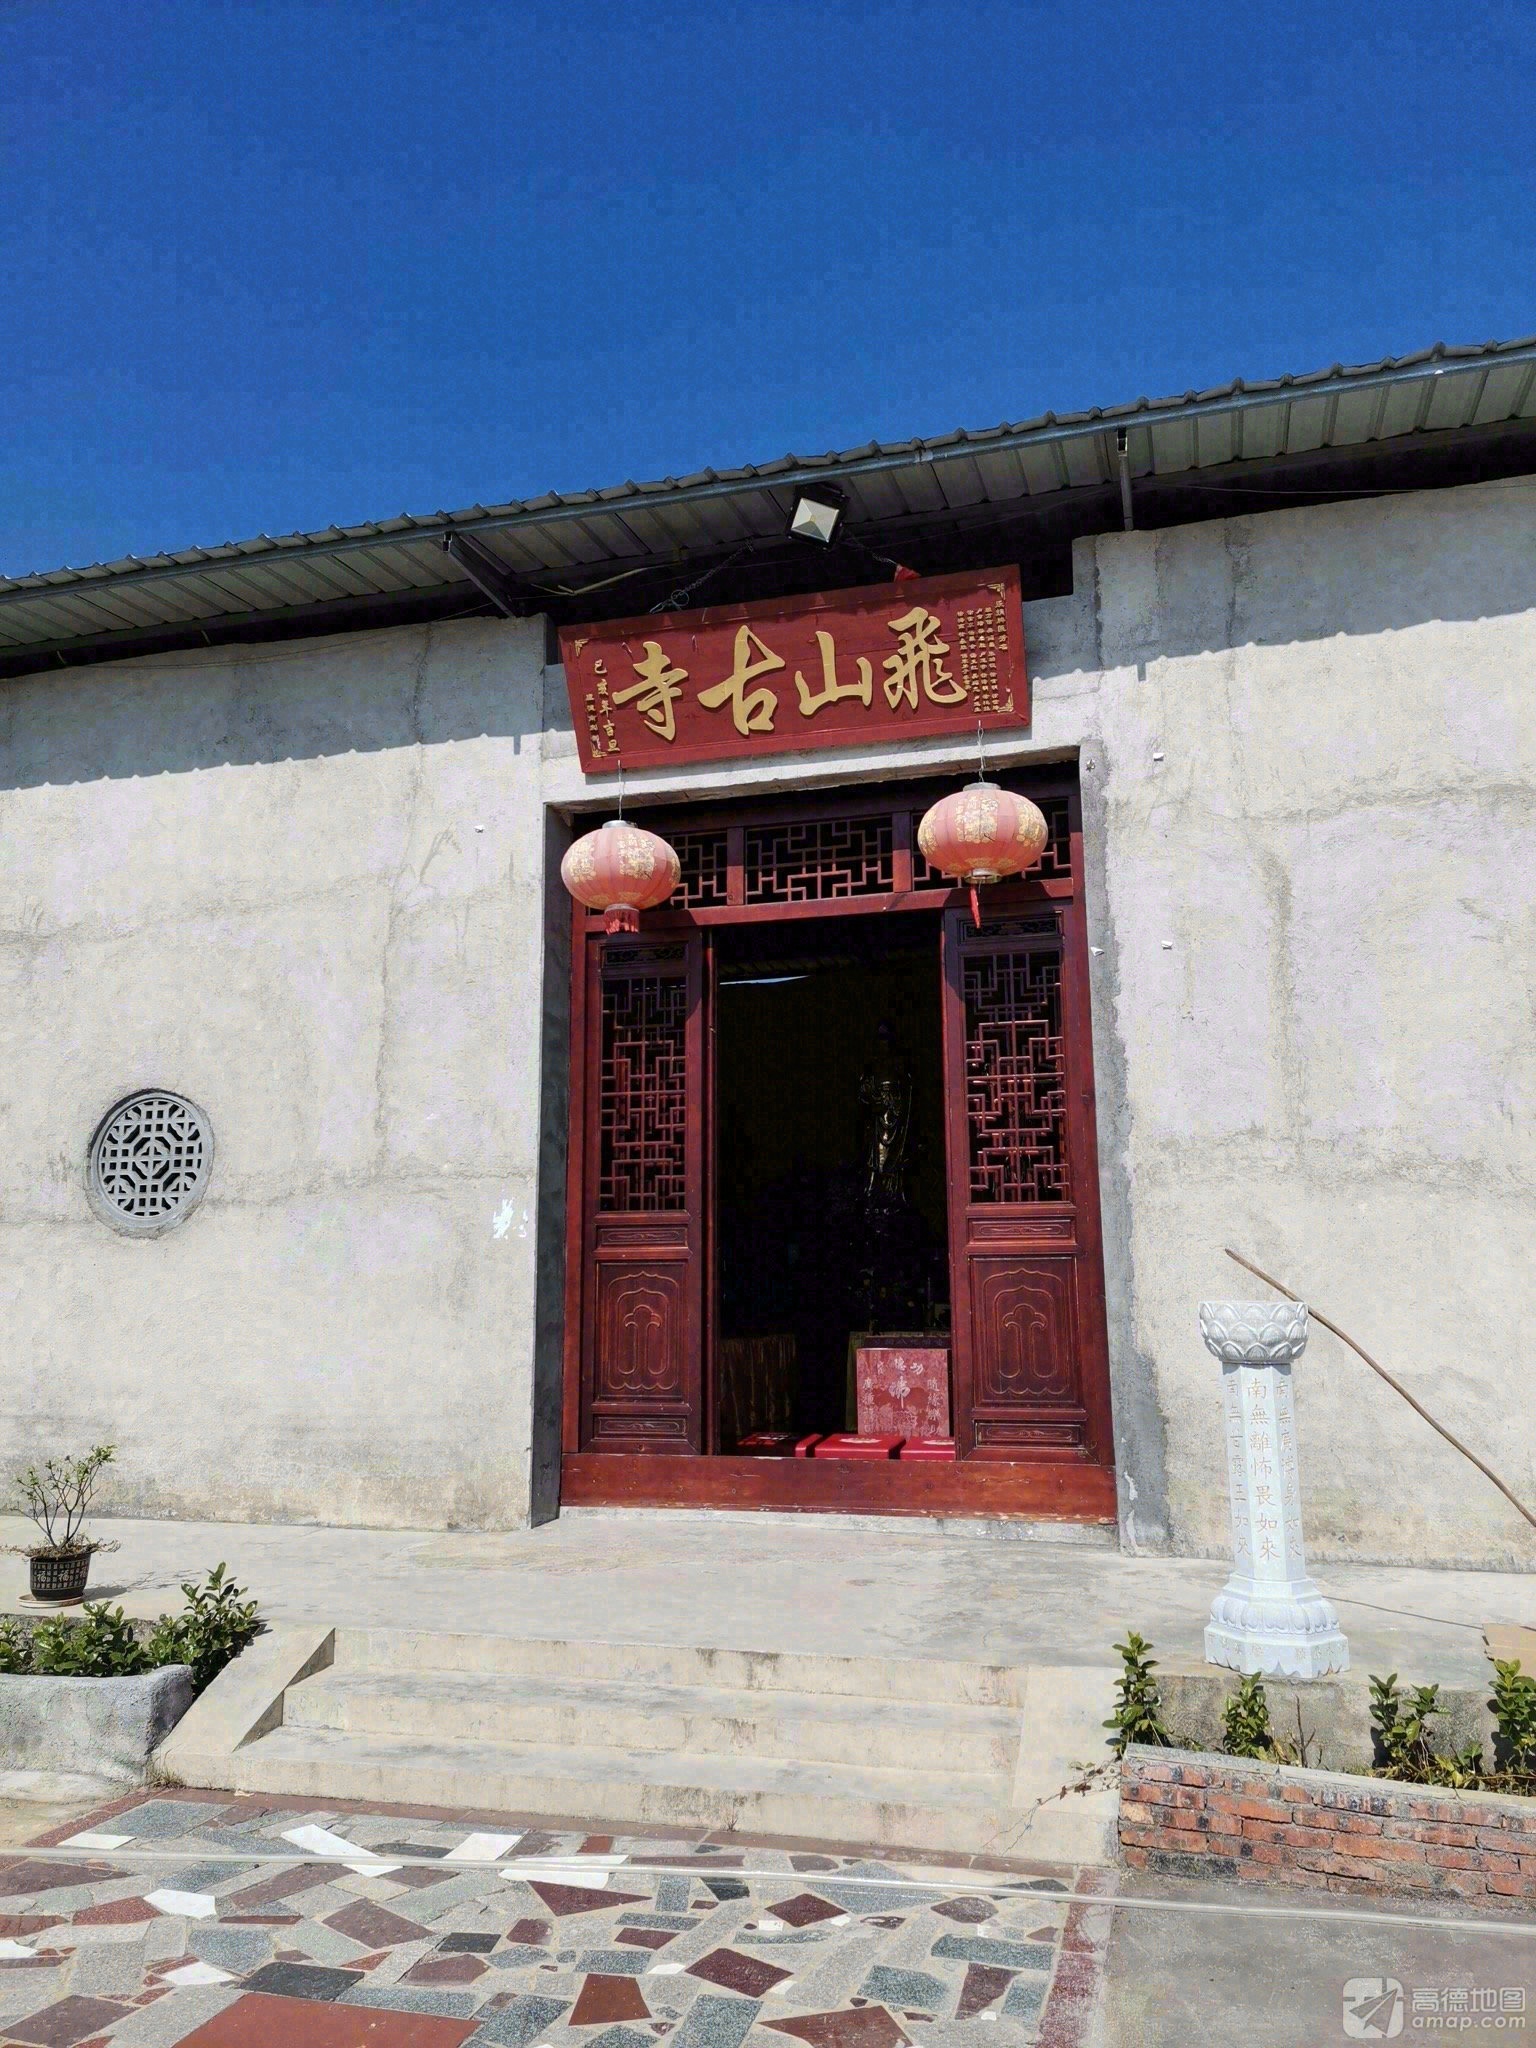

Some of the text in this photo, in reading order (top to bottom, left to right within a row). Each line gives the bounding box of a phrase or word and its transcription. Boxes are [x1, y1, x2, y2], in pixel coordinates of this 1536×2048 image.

[613, 606, 967, 741] 飛山古寺
[889, 1374, 911, 1409] 佛
[1247, 1378, 1281, 1560] 南無離怖畏如來
